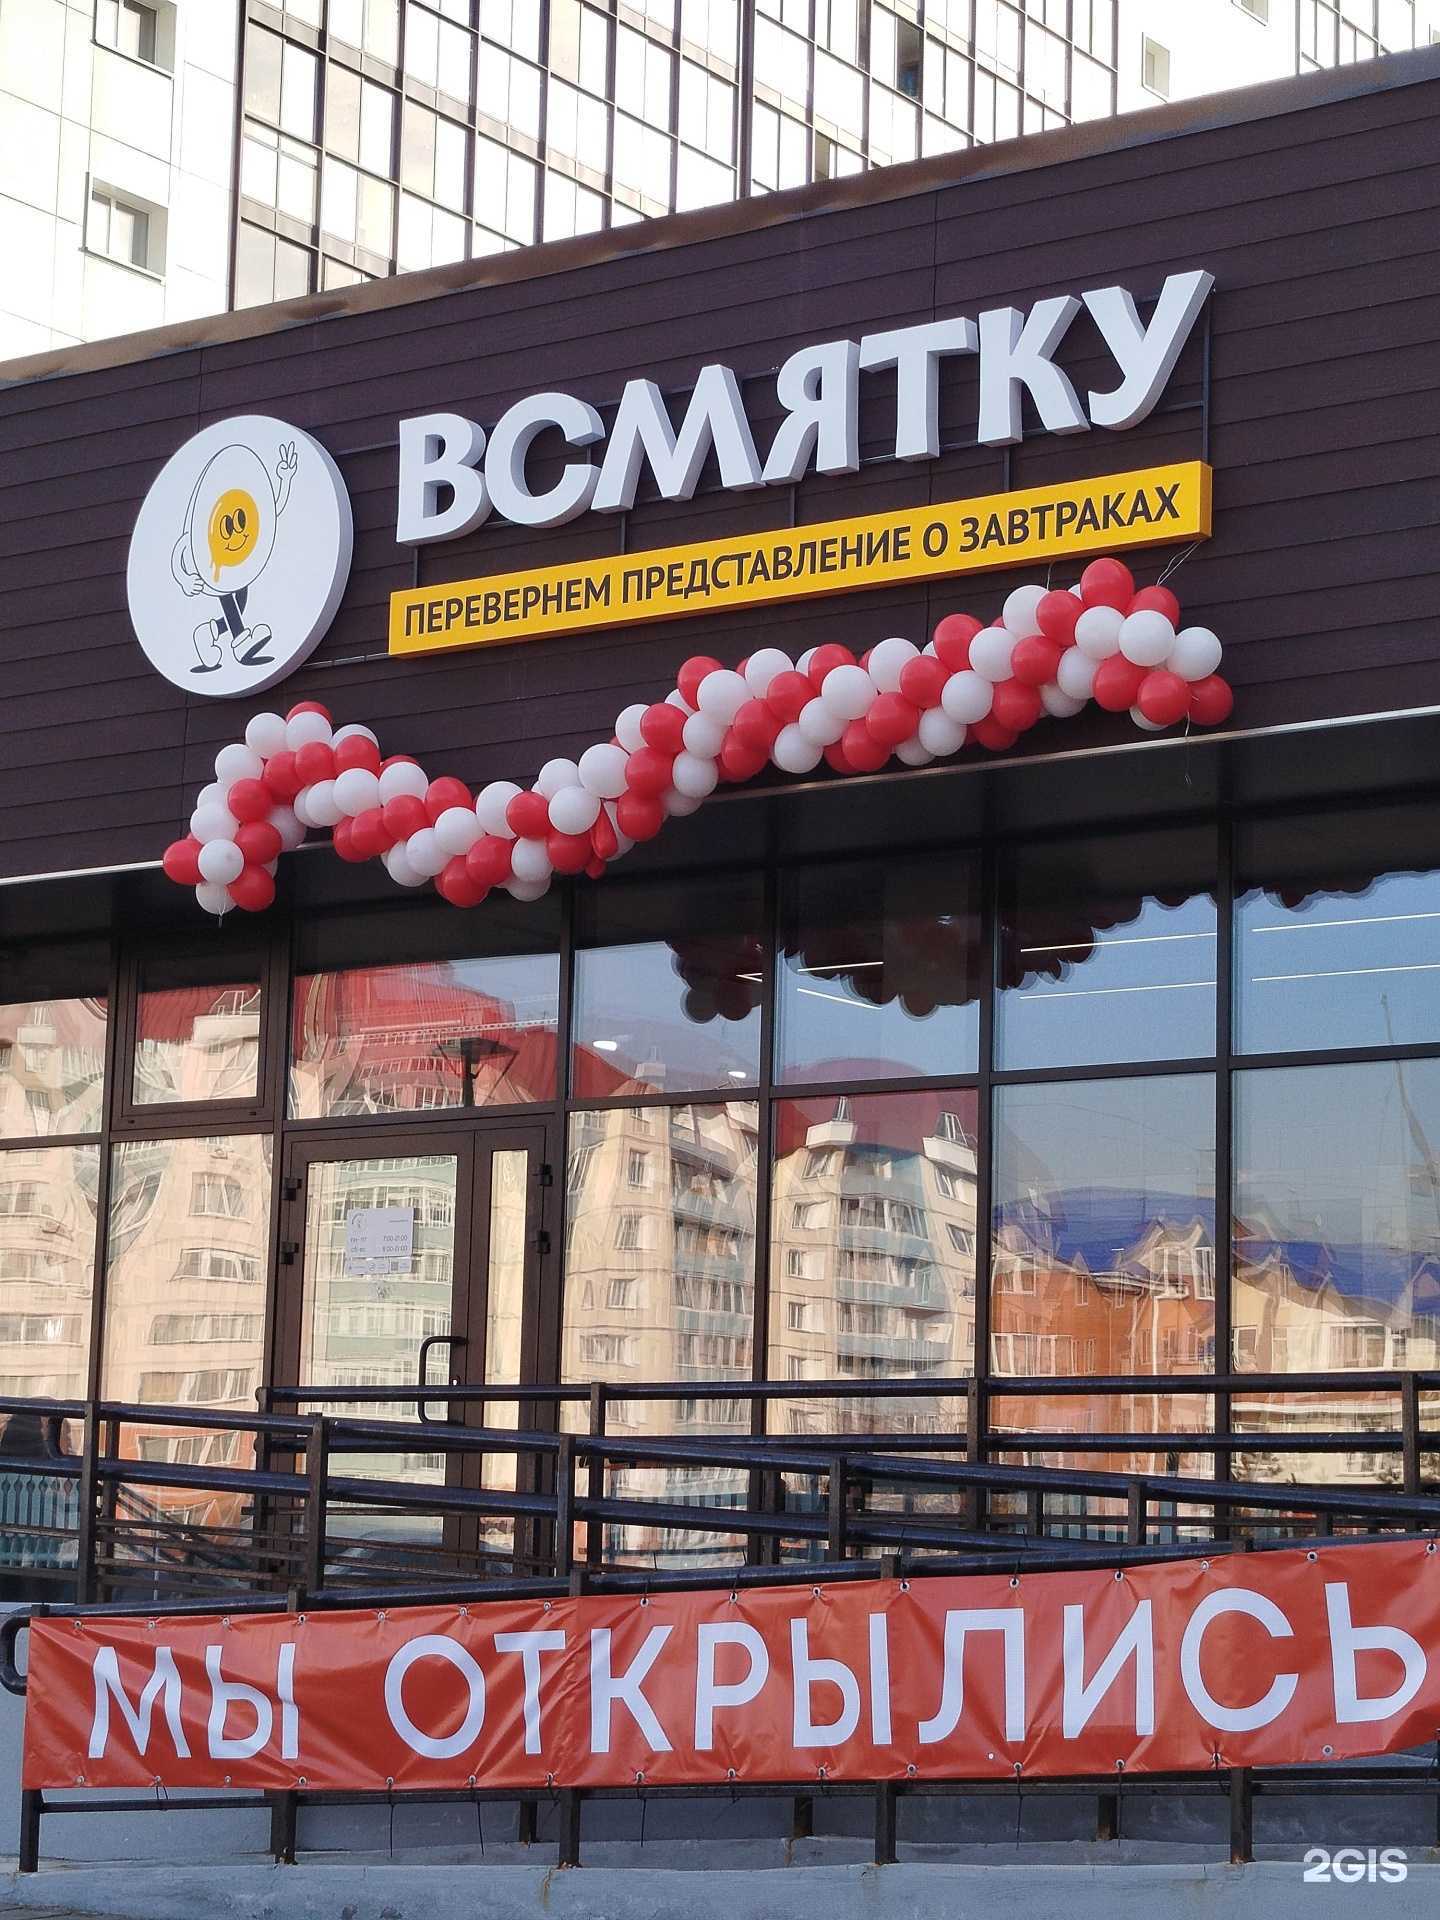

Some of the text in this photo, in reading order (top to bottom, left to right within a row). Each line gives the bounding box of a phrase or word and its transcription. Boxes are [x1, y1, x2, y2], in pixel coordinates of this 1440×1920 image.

[396, 269, 1215, 544] ВСМЯТКУ
[404, 483, 1182, 637] ПЕРЕВЕРНЕМ ПРЕДСТАВЛЕНИЕ О ЗАВТРАКАХ
[88, 1582, 1428, 1760] МЫ ОТКРЫЛИСЬ
